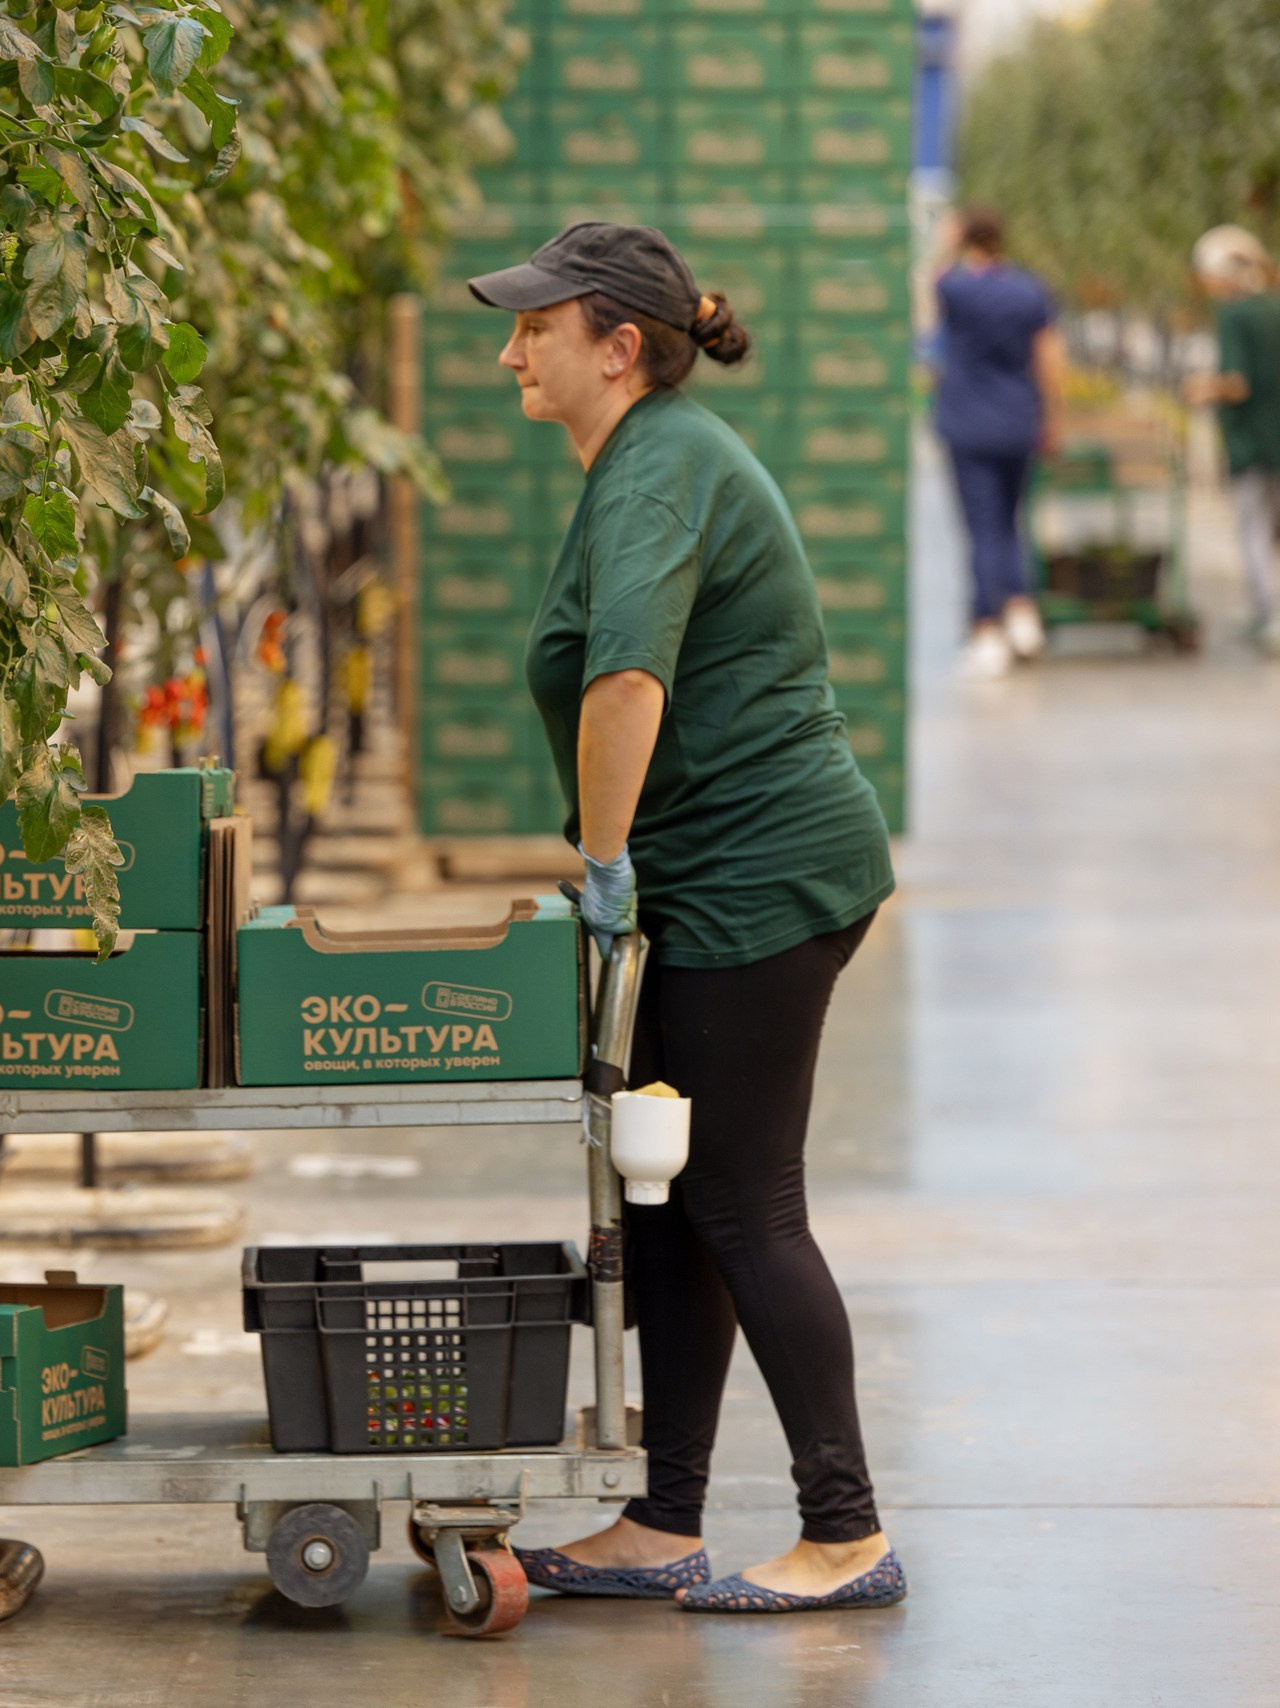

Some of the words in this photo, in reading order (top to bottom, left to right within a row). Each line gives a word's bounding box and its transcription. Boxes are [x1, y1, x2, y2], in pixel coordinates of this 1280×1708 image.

[304, 1025, 499, 1055] КУЛЬТУРА
[66, 1065, 120, 1079] уверен
[304, 1060, 360, 1072] овощи,
[363, 1059, 372, 1069] в
[376, 1058, 440, 1070] которых
[445, 1055, 500, 1070] уверен
[42, 1384, 105, 1427] КУЛЬТУРА
